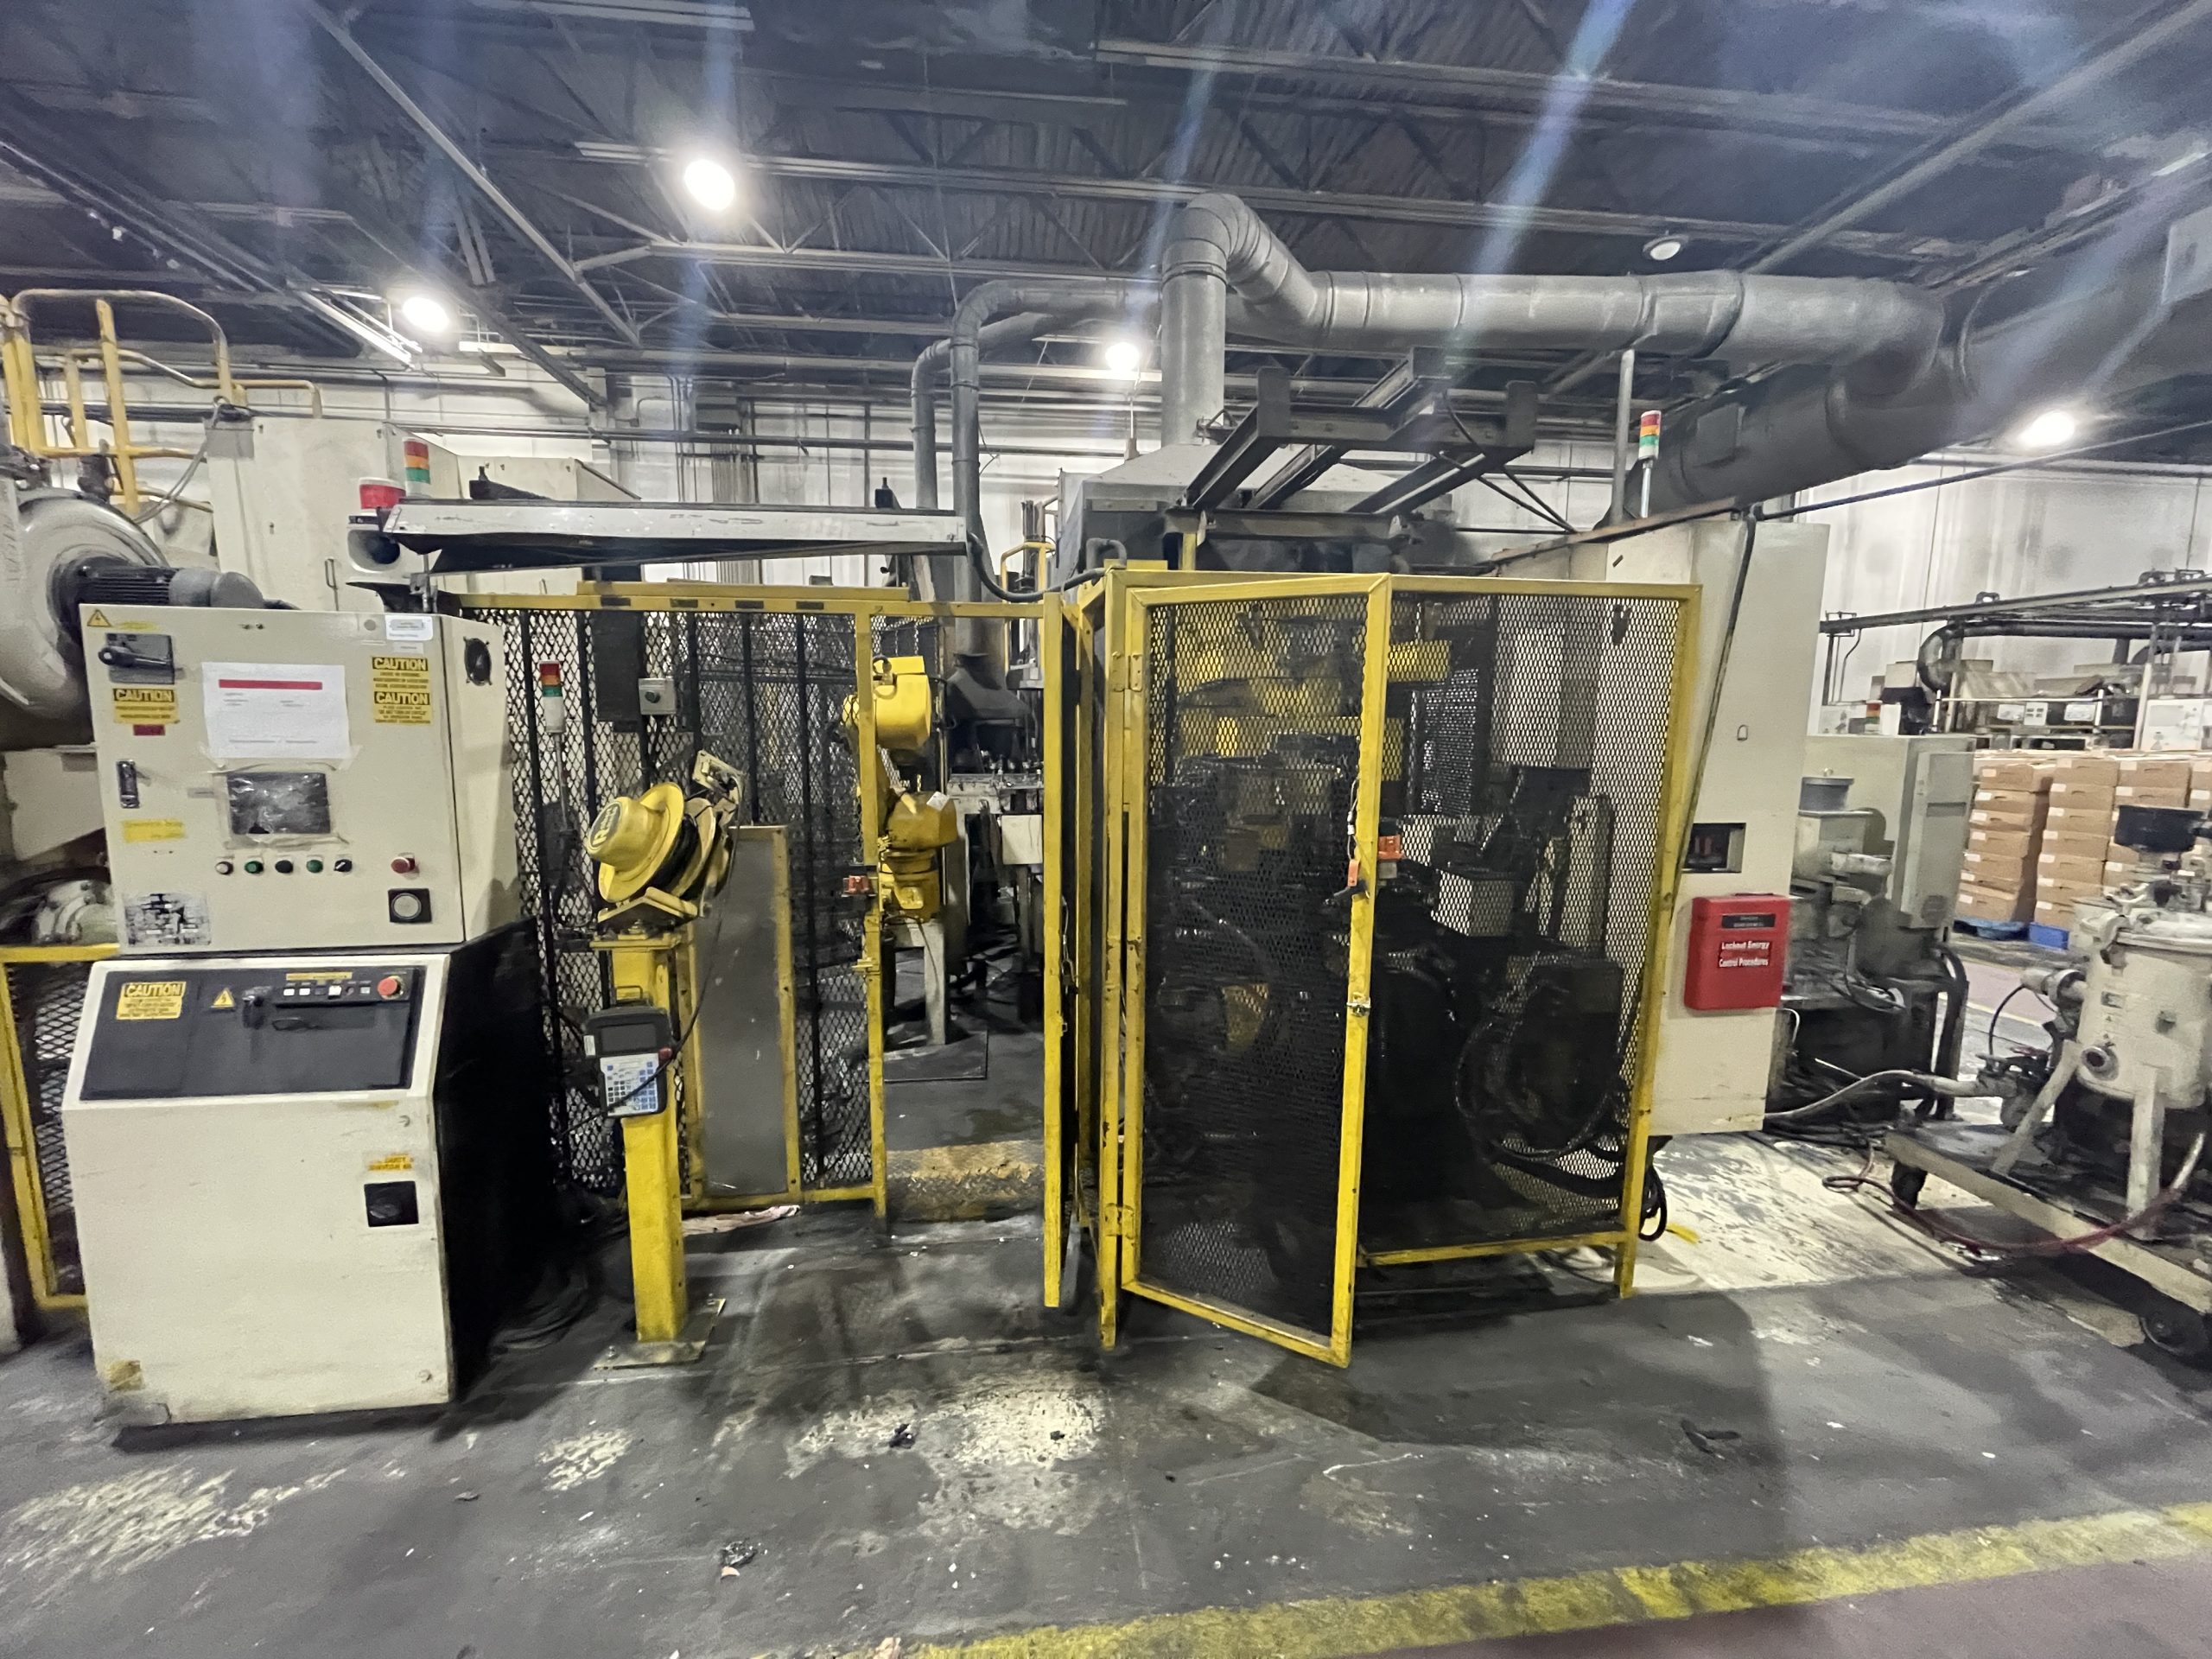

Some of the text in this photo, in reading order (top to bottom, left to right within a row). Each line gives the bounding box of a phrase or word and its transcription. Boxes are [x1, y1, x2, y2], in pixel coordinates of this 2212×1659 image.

[374, 658, 427, 671] CAUTION
[116, 690, 173, 702] CAUTION
[376, 692, 429, 705] CAUTION
[1747, 941, 1770, 950] Energy
[1719, 957, 1738, 967] Control
[126, 983, 182, 996] CAUTION
